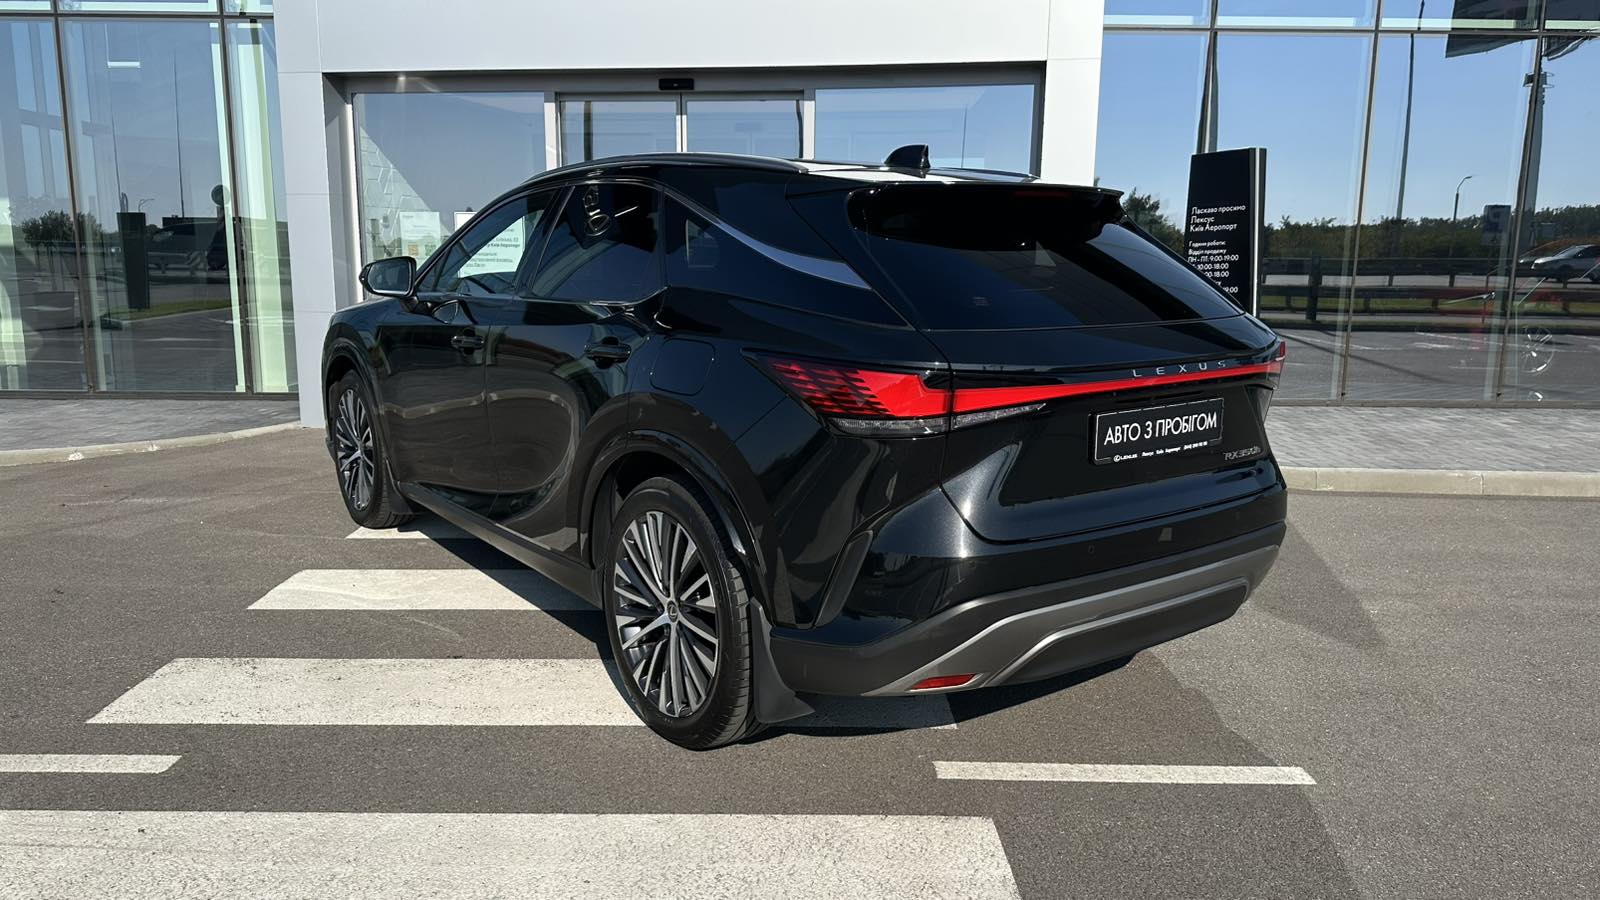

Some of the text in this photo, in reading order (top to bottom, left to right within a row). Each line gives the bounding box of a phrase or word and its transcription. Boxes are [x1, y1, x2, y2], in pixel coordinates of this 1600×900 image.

[1191, 205, 1246, 215] Ласкаво просимо
[1190, 215, 1215, 224] Лексус
[1189, 223, 1238, 232] Київ Аеропорт
[1132, 360, 1227, 378] LEXUS
[1104, 411, 1217, 446] АВТО З ПРОБІГОМ
